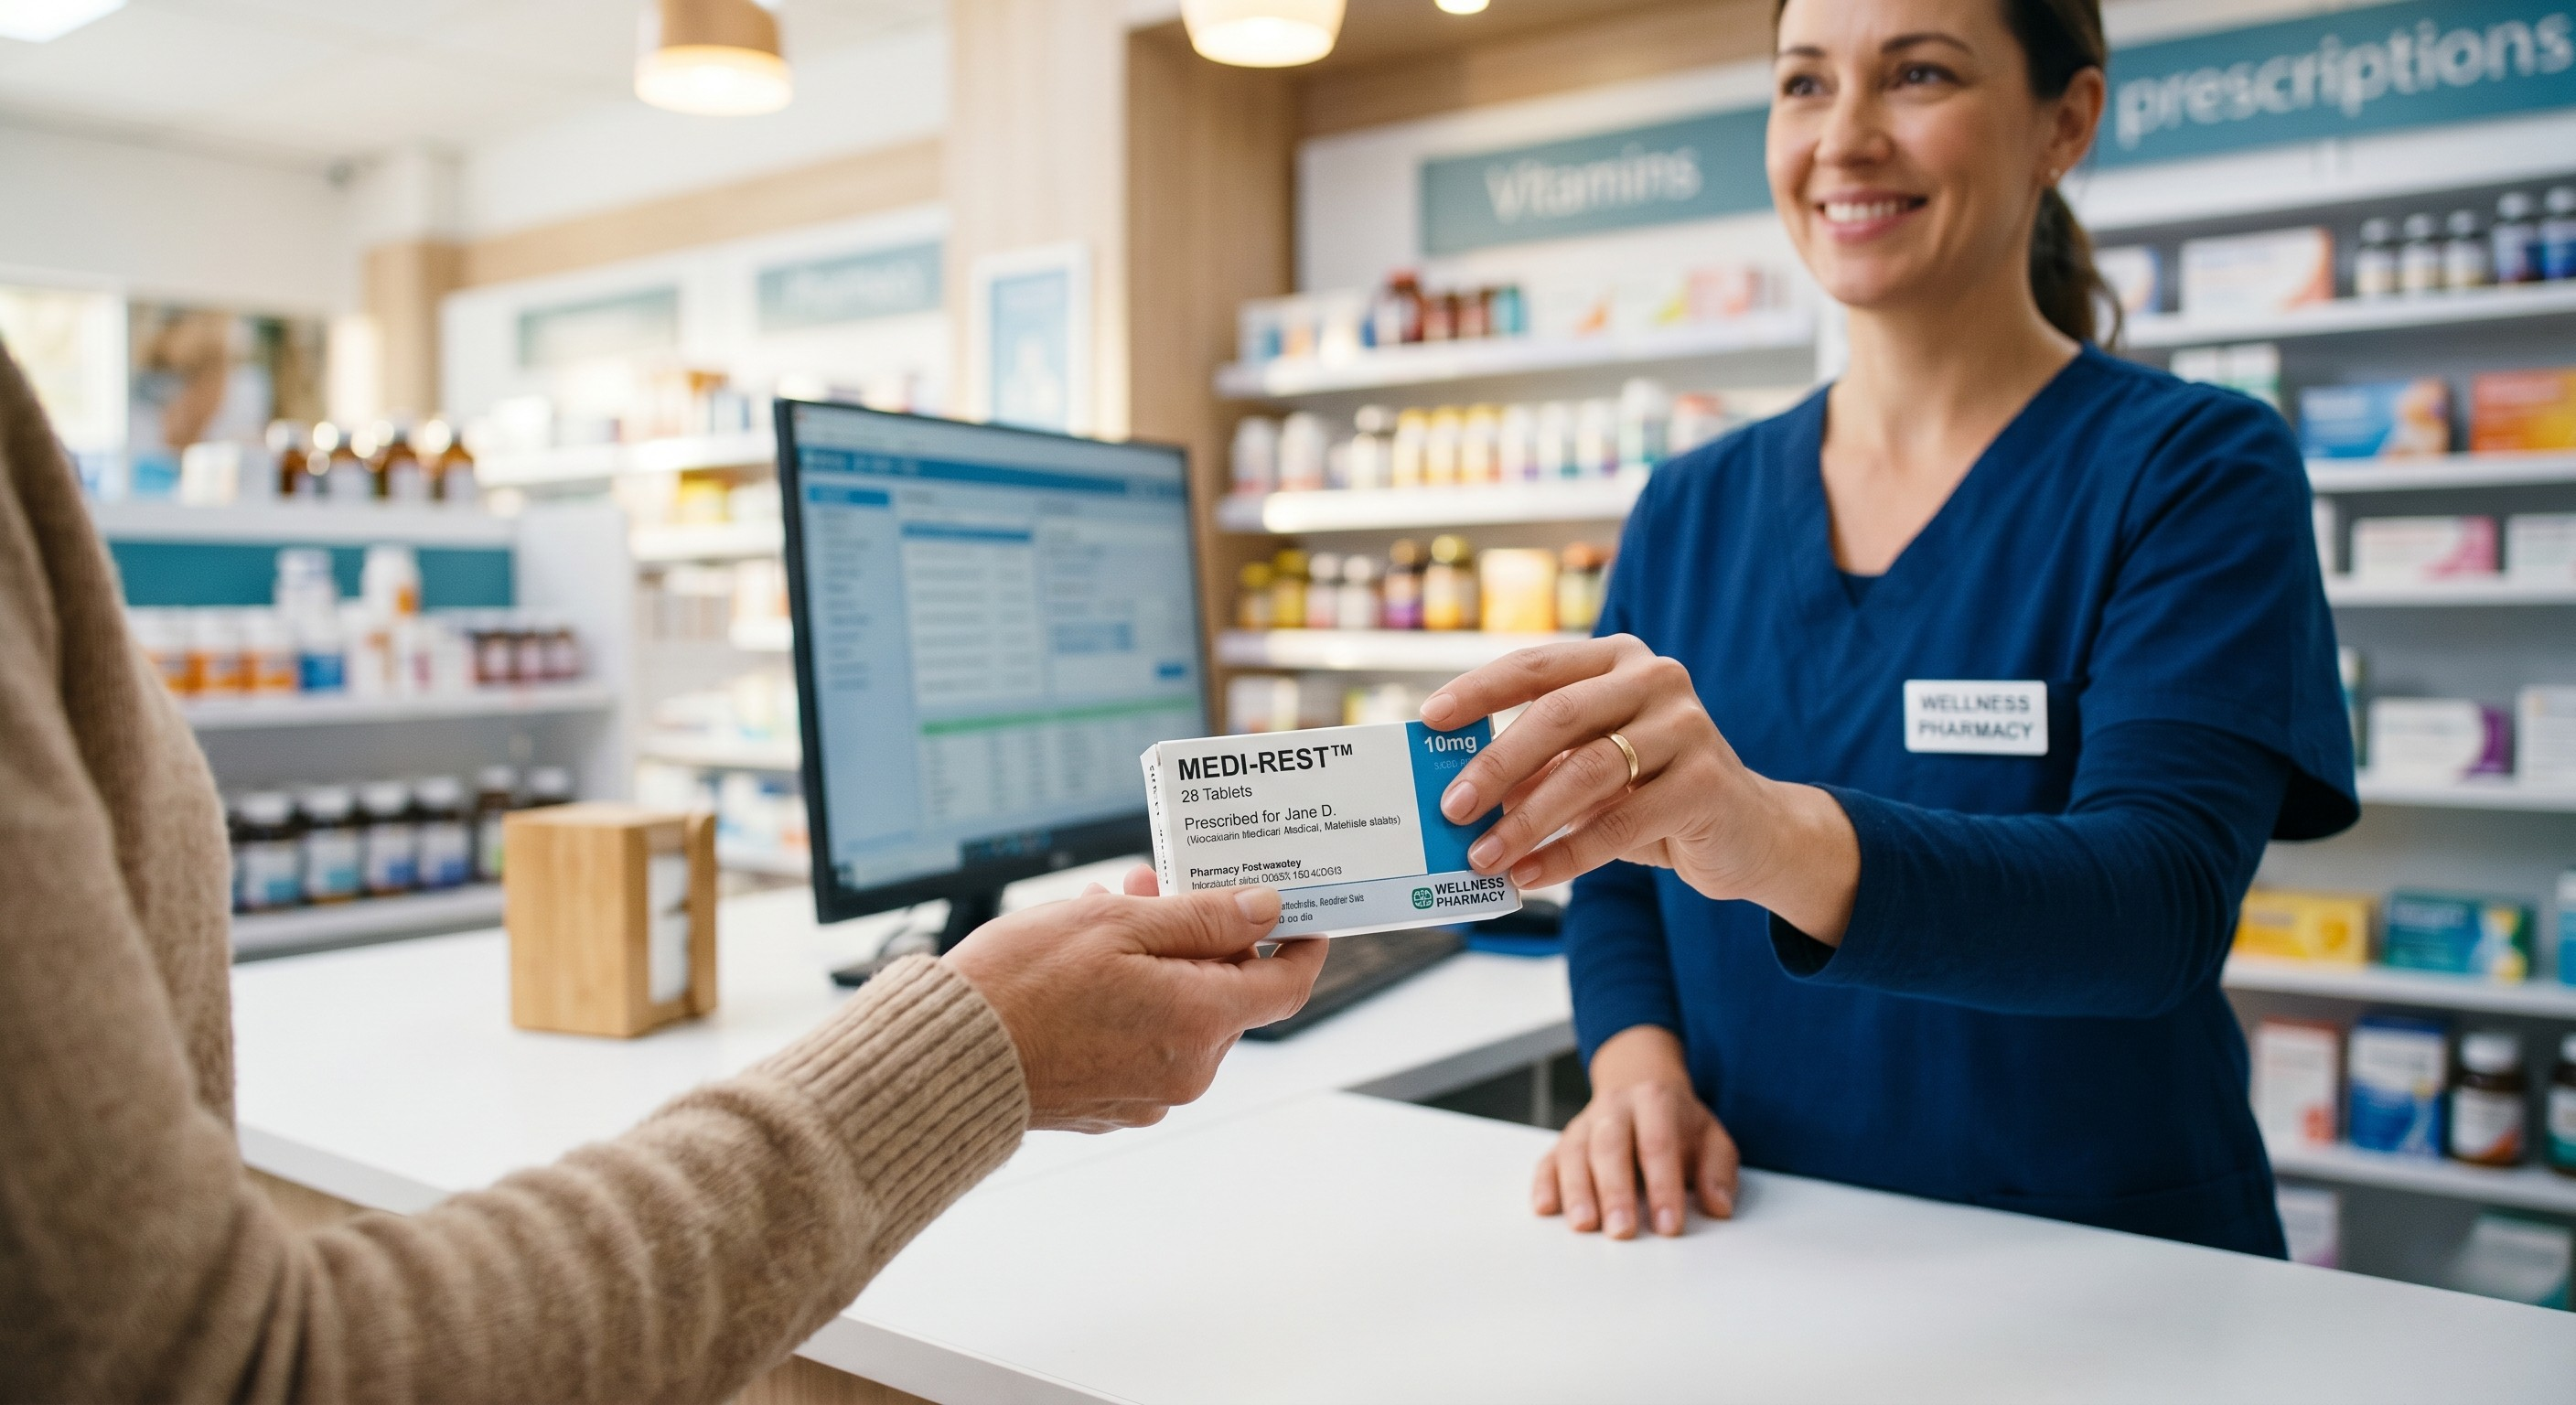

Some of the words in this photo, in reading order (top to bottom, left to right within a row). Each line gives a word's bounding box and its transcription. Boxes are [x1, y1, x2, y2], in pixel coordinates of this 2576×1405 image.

[2116, 14, 2575, 151] prescriptions
[1485, 142, 1701, 225] Vitamins
[1921, 694, 2030, 713] WELLNESS
[1919, 720, 2034, 741] PHARMACY
[1424, 735, 1477, 753] 10mg
[1182, 789, 1199, 803] 28
[1202, 786, 1253, 801] Tablets
[1185, 811, 1259, 831] Prescribed
[1261, 810, 1281, 823] for
[1285, 808, 1317, 820] Jane
[1321, 804, 1336, 817] D.
[1190, 865, 1240, 878] Pharmacy
[1435, 877, 1505, 895] WELLNESS
[1436, 890, 1506, 907] PHARMACY
